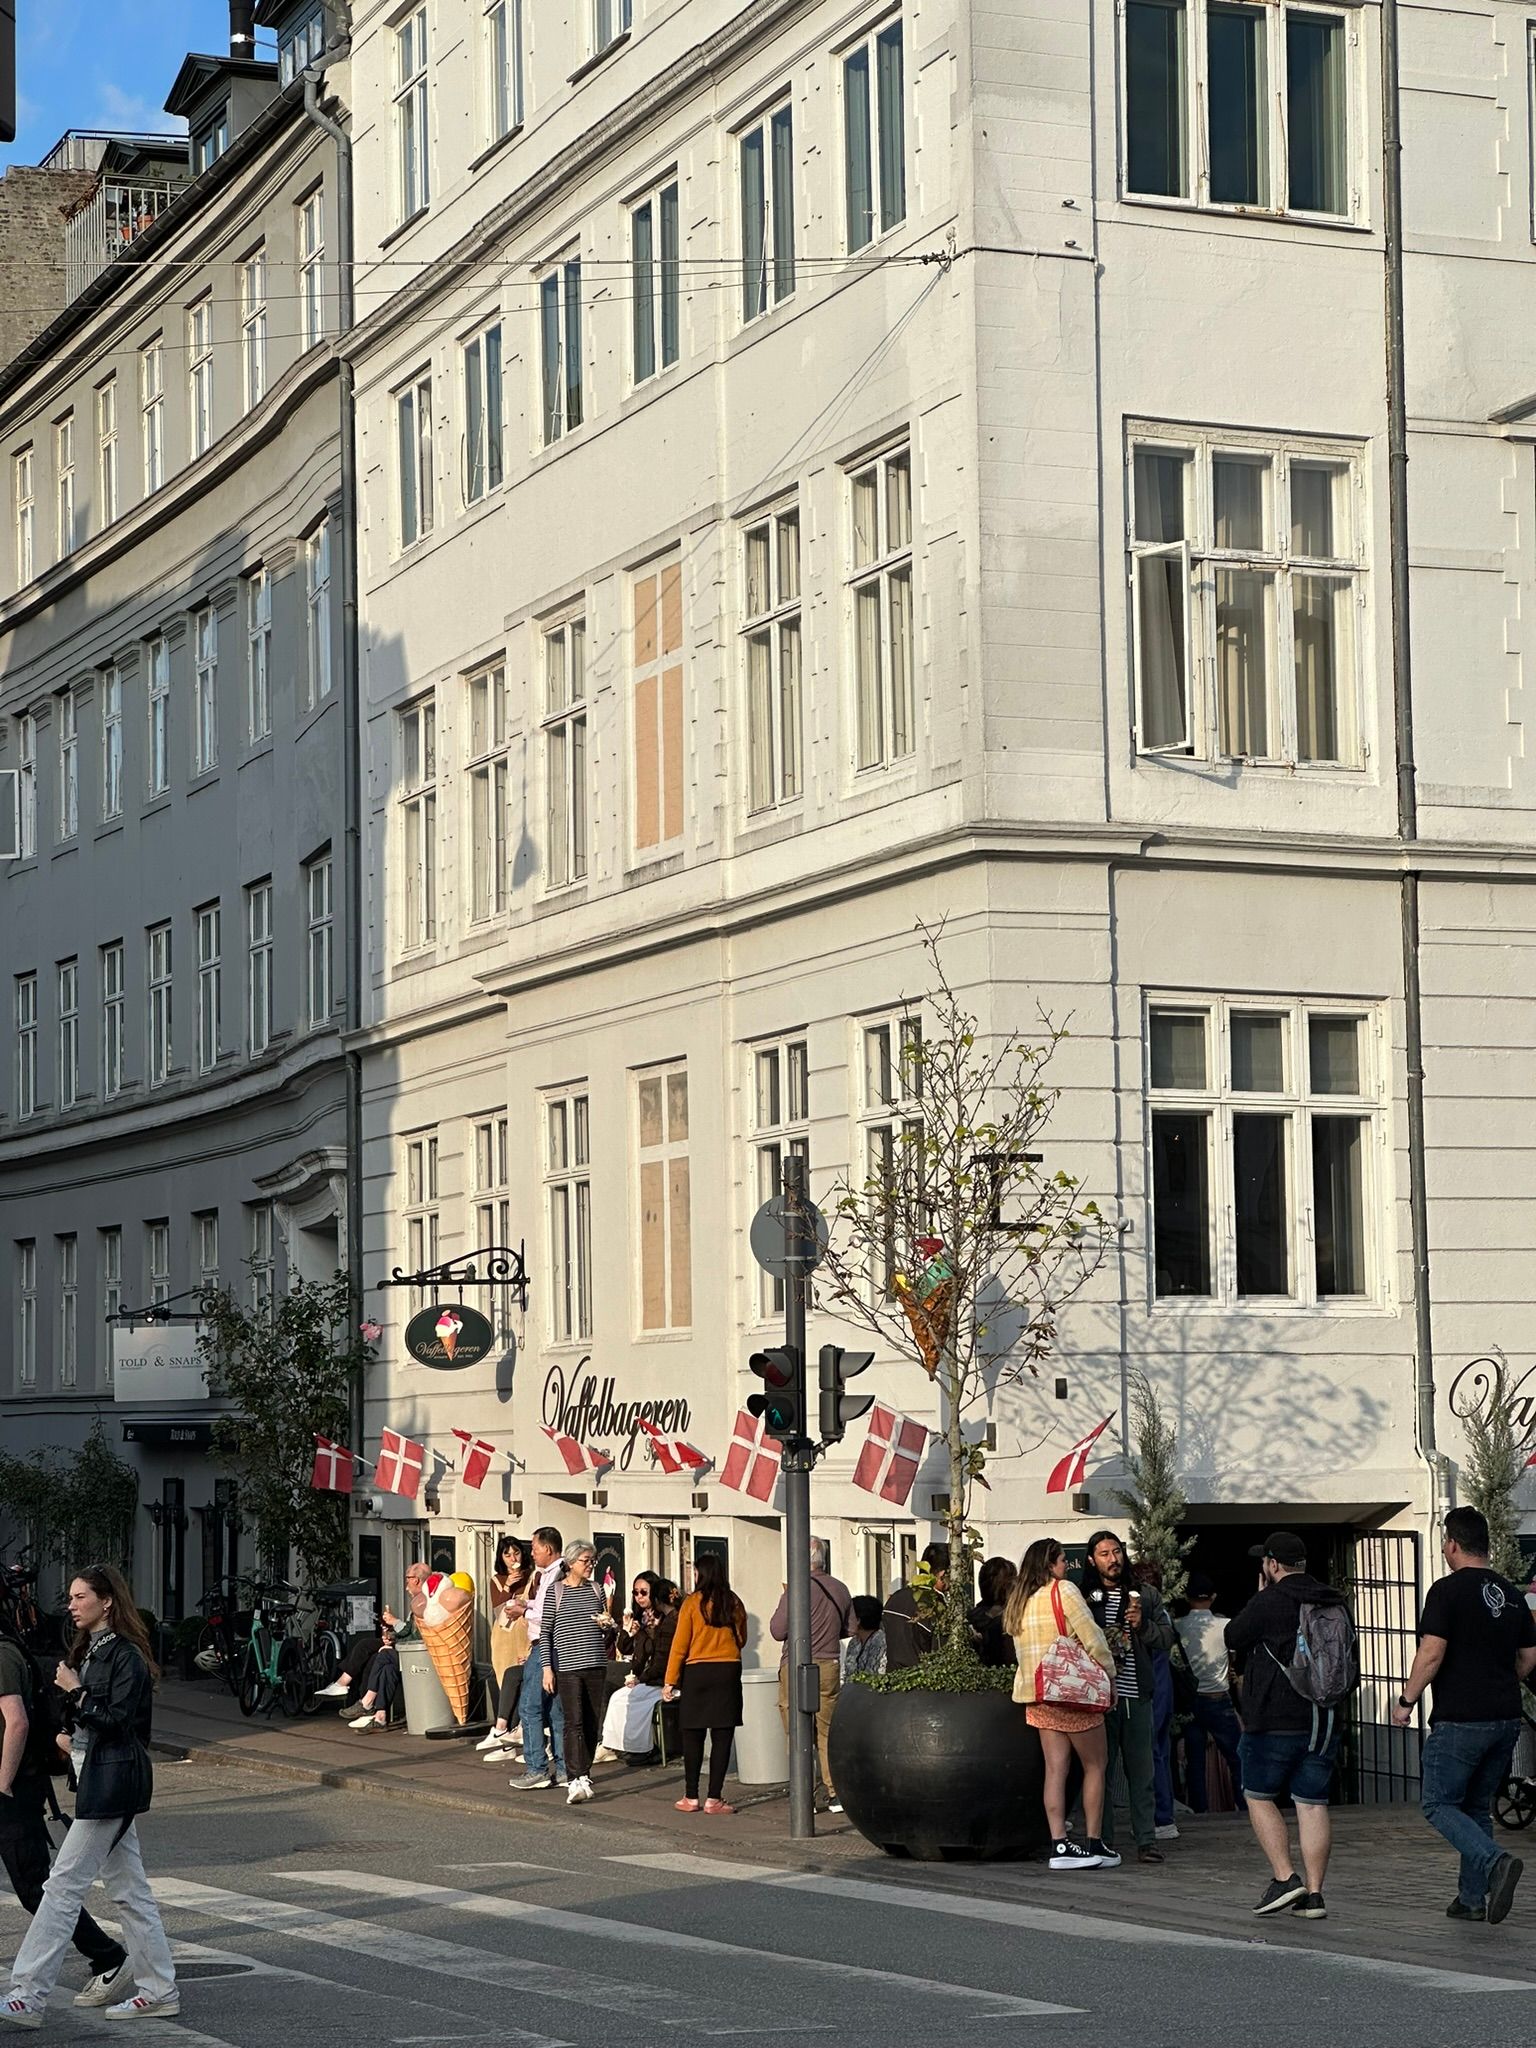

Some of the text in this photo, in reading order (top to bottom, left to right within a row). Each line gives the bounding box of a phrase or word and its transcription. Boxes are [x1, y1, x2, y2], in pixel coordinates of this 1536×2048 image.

[415, 1340, 480, 1358] Vaffegeren
[119, 1356, 202, 1367] TOLD & SNAPS
[543, 1356, 691, 1471] Vaffelbageren
